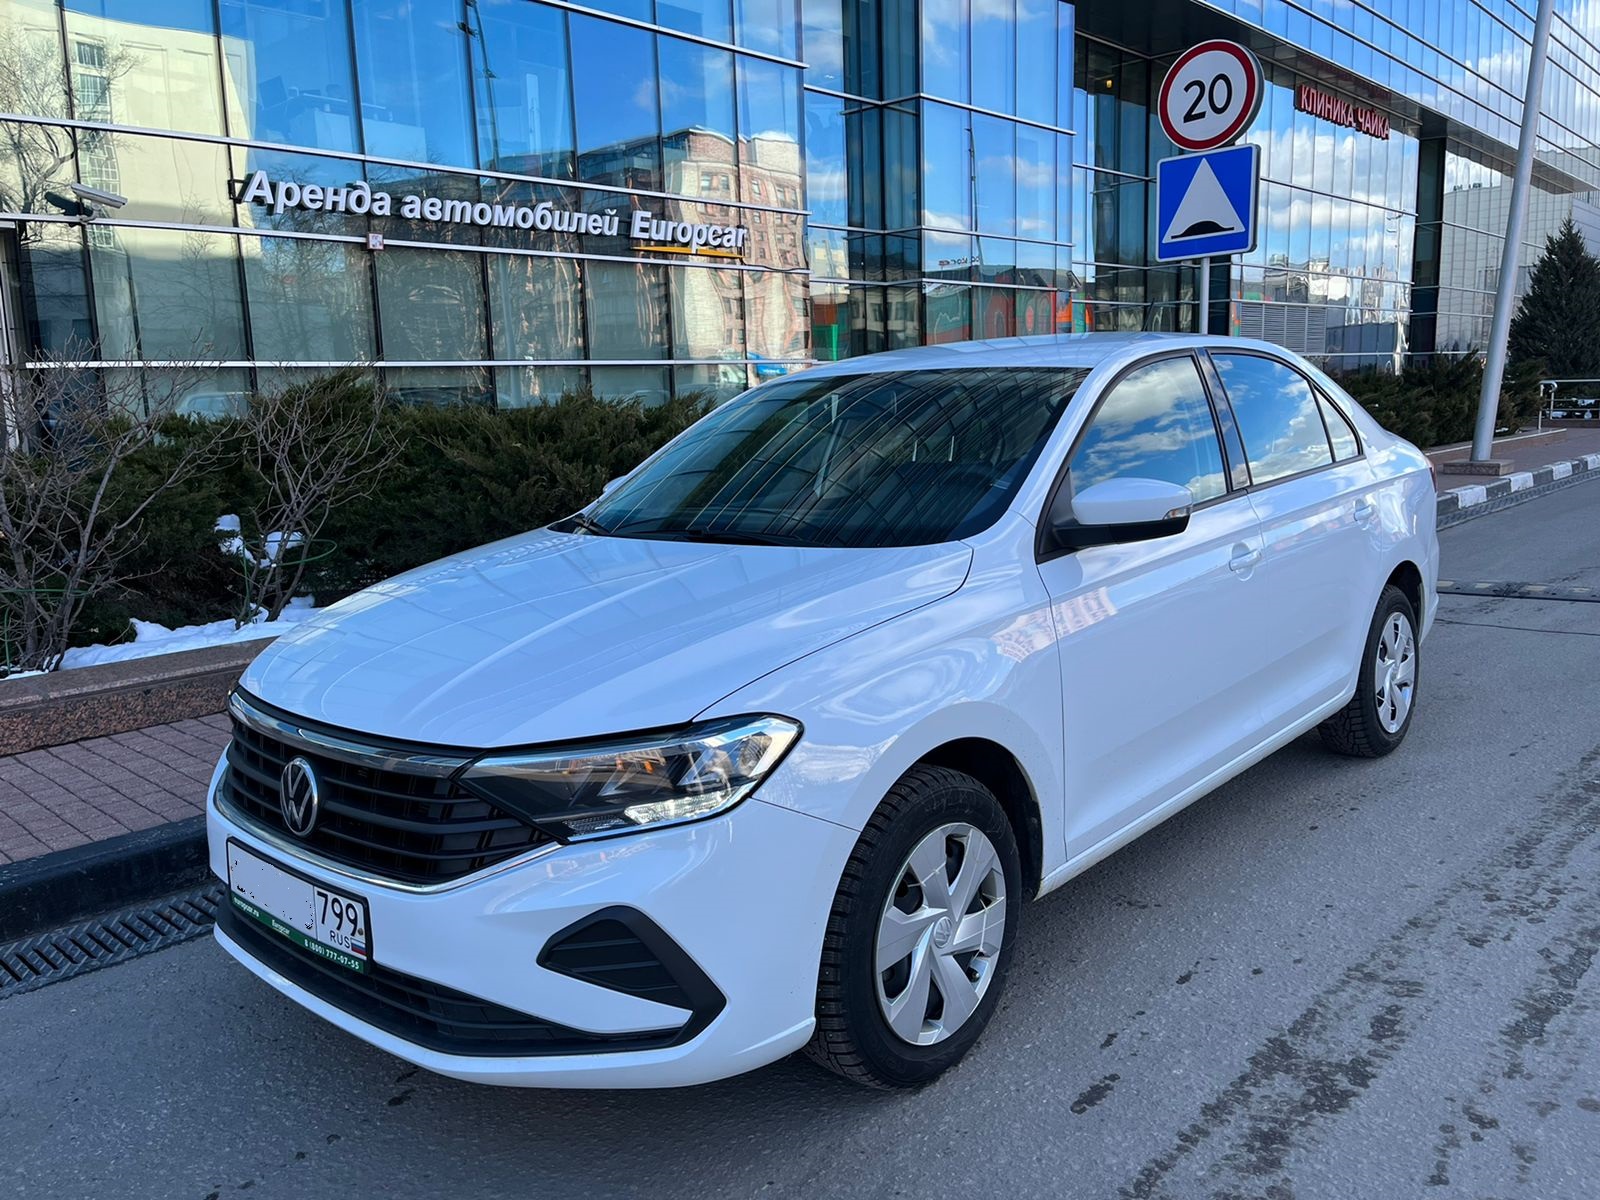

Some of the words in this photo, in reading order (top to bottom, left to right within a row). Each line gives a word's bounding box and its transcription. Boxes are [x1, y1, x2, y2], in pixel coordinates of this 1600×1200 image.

[1183, 73, 1233, 123] 20
[1300, 84, 1357, 128] КЛИНИКА
[1357, 107, 1390, 139] ЧАЙКА
[243, 169, 391, 216] Аренда
[401, 194, 619, 236] автомобилей
[631, 210, 747, 253] Europcar
[317, 890, 358, 937] 799
[326, 949, 360, 970] 777-07-55
[329, 929, 350, 949] RUS
